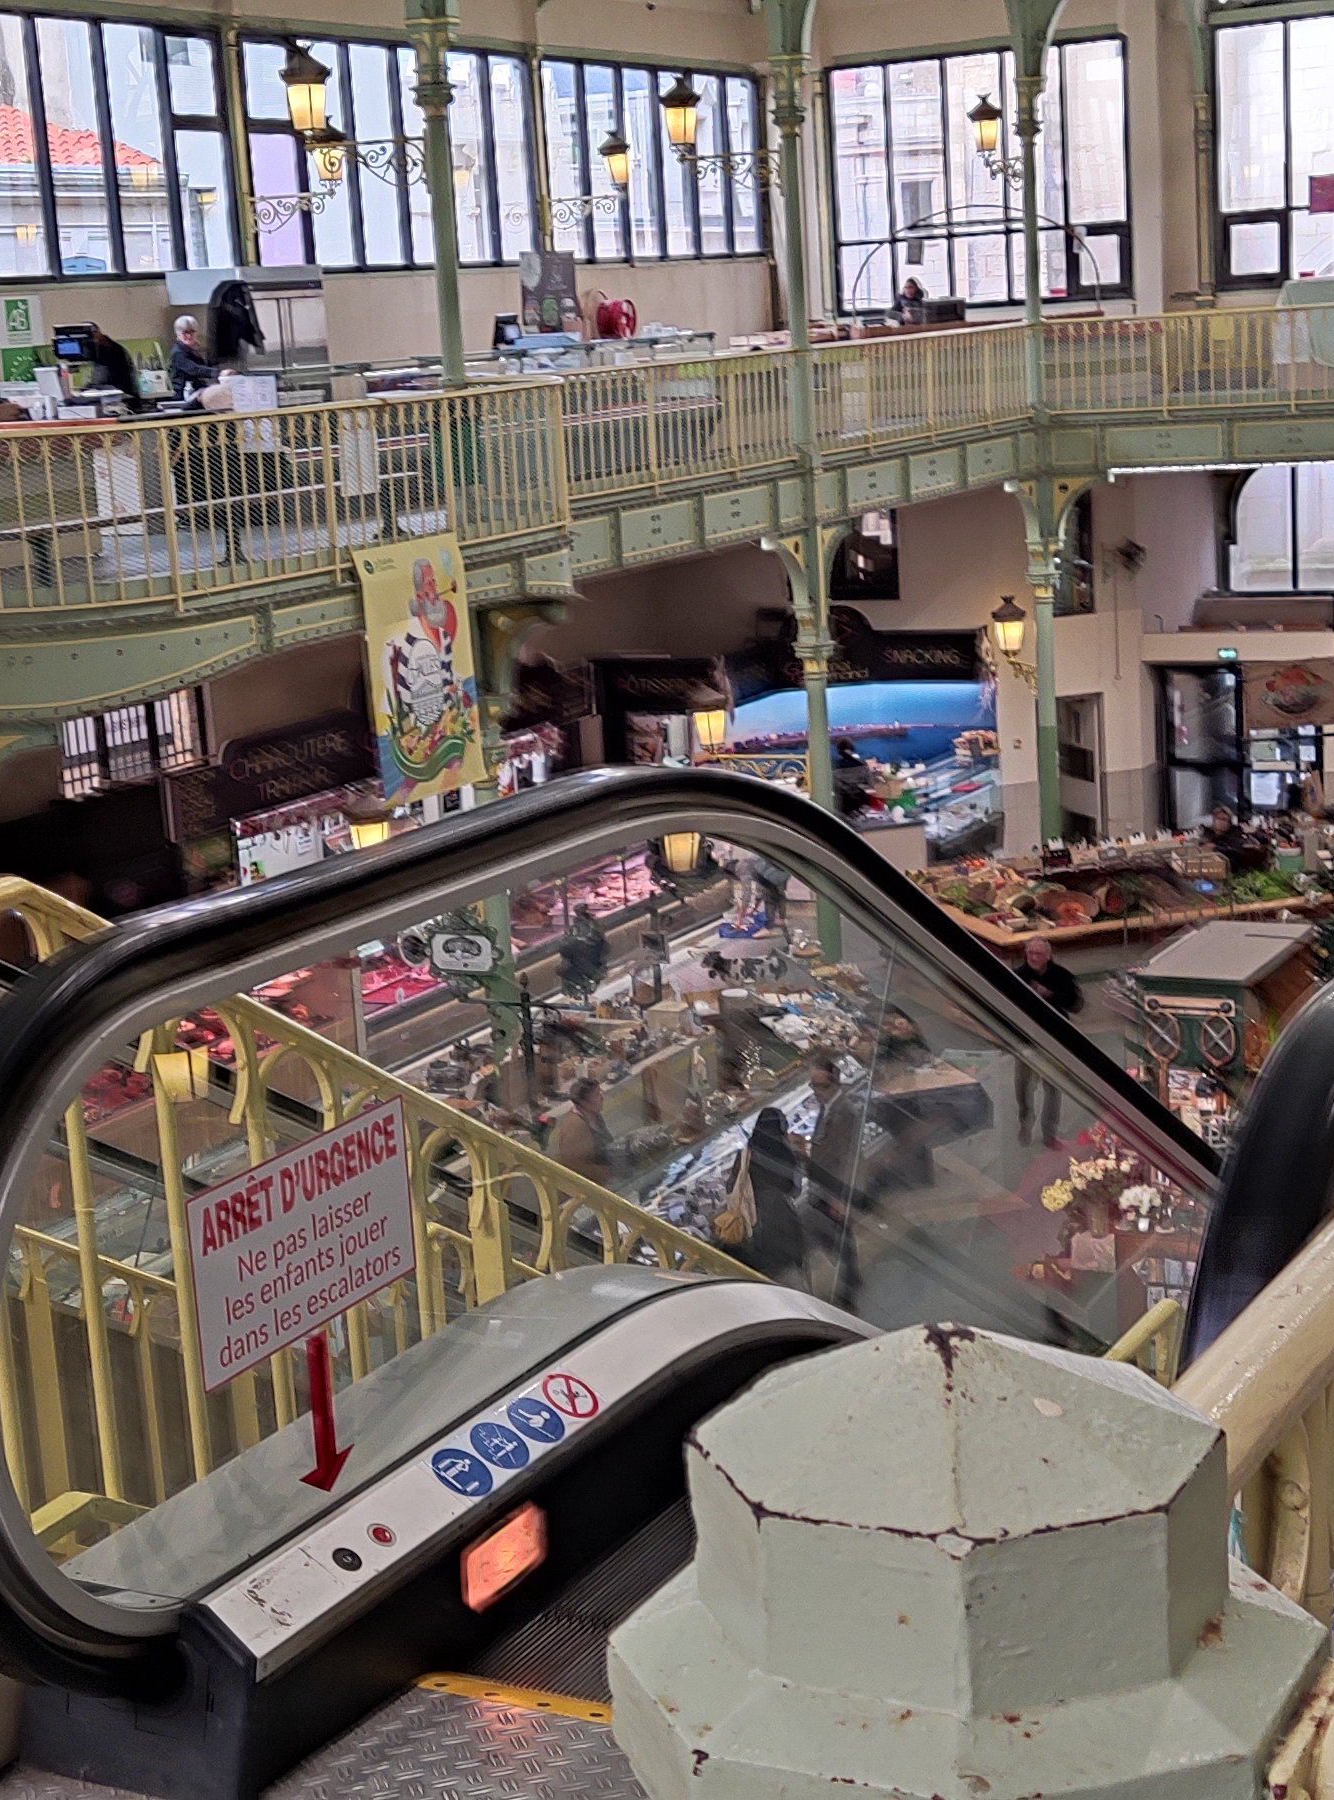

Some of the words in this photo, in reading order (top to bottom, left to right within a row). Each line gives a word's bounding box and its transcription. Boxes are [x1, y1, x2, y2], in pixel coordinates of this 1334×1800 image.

[202, 1174, 275, 1258] ARRÊT
[279, 1112, 399, 1215] D'URGENCE
[237, 1249, 268, 1283] Ne
[273, 1226, 308, 1270] pas
[311, 1189, 373, 1242] laisser
[219, 1322, 270, 1369] dans
[274, 1303, 303, 1337] les
[306, 1245, 402, 1316] escalators
[225, 1292, 255, 1327] les
[260, 1247, 336, 1306] enfants
[338, 1214, 389, 1268] jouer
